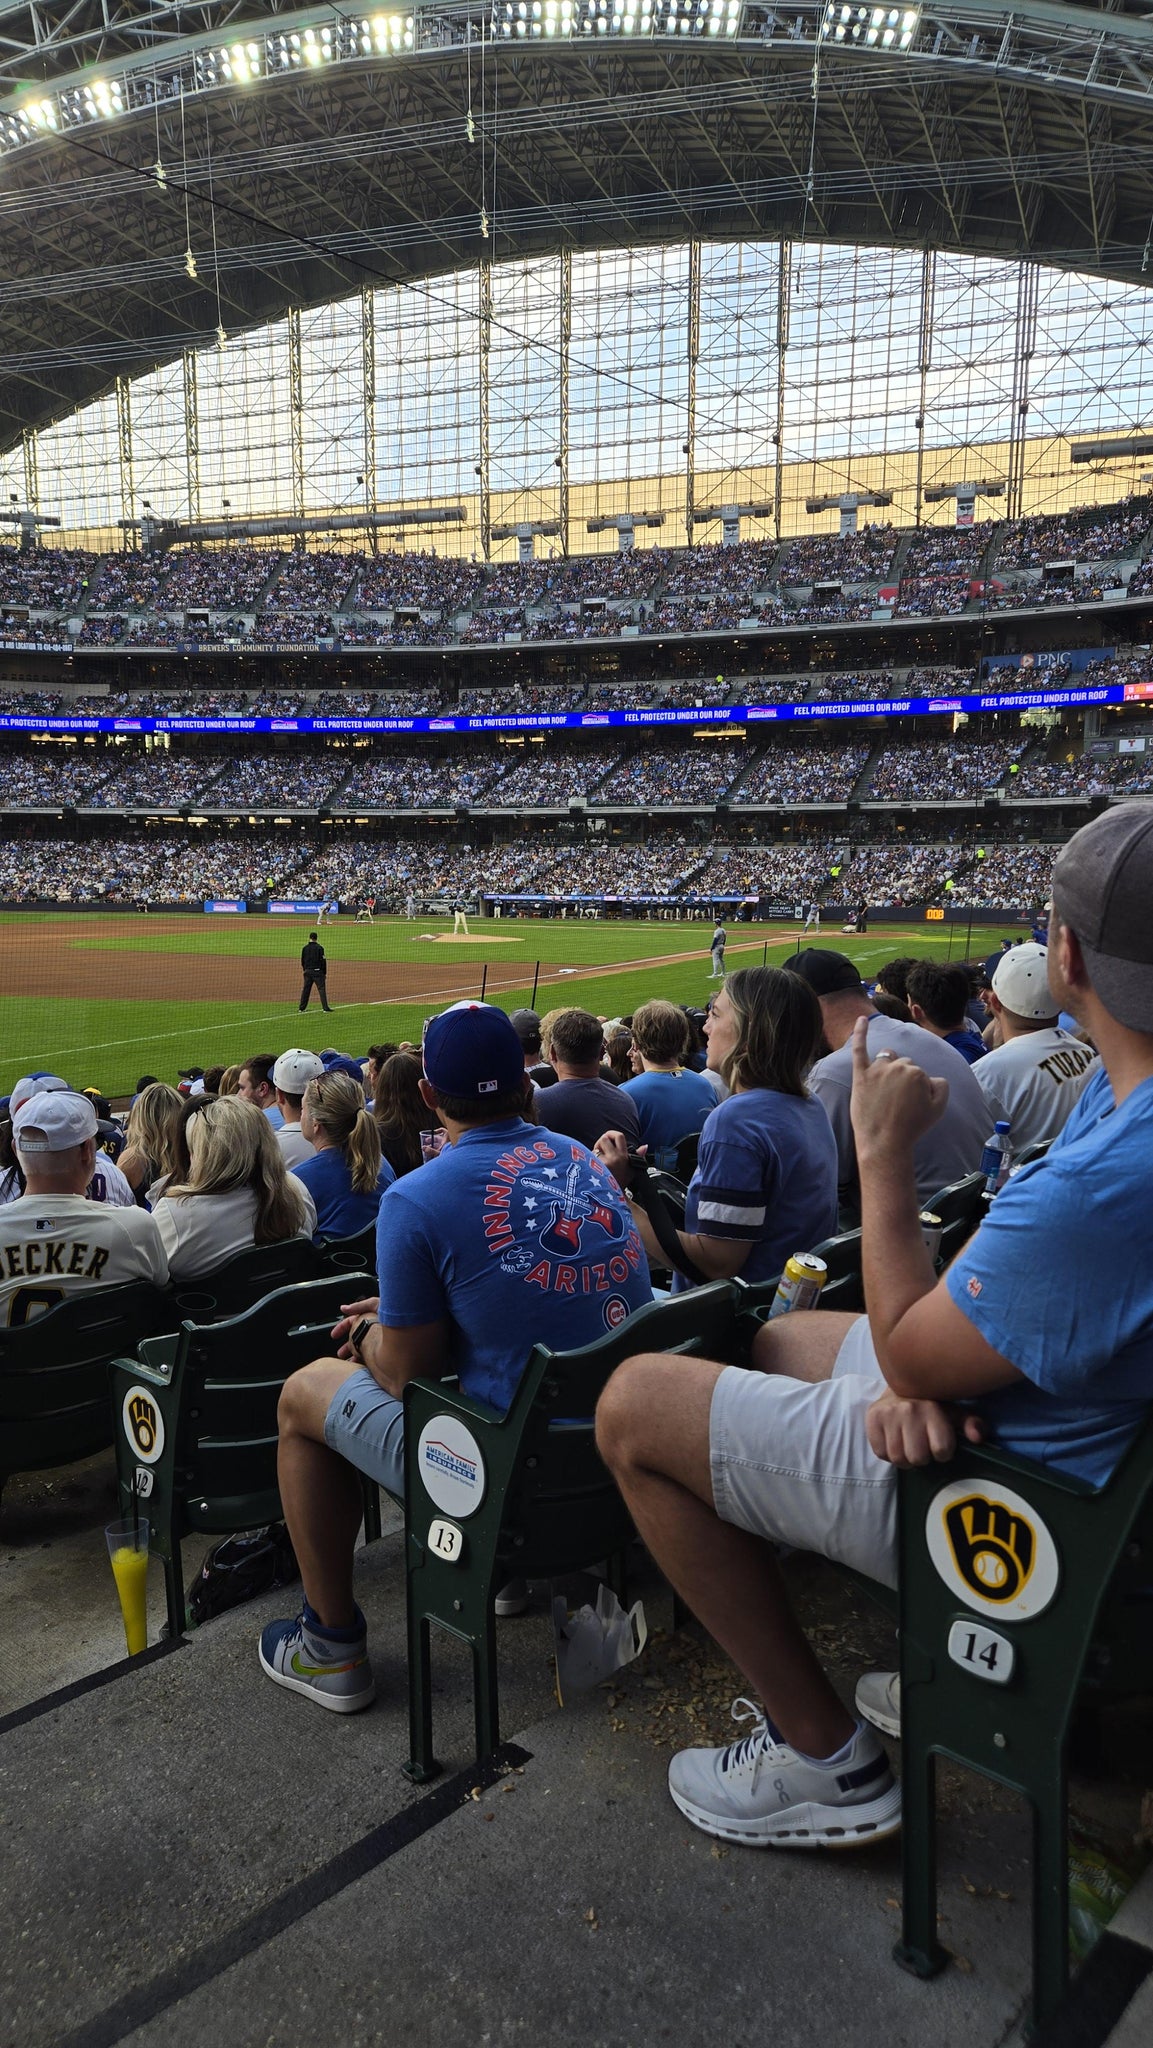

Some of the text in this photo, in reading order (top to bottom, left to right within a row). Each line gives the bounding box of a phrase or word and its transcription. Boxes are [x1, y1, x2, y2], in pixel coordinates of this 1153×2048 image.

[15, 642, 36, 650] LOCATION
[198, 644, 320, 652] BREWERS COMMUNITY FOUNDATION
[1037, 652, 1071, 666] PNC
[980, 690, 1108, 707] FEEL PROTECTED UNDER OUR ROOF
[624, 709, 731, 722] FEEL PROTECTED UNDER OUR ROOF
[794, 702, 911, 715] FEEL PROTECTED UNDER OUR ROOF
[10, 718, 47, 728] PROTECTED
[48, 719, 69, 728] UNDER
[70, 720, 83, 728] OUR
[83, 720, 99, 728] ROOF
[156, 720, 256, 729] FEEL PROTECTED UNDER OUR ROOF
[313, 720, 414, 729] FEEL PROTECTED UNDER OUR ROOF
[469, 716, 567, 727] FEEL PROTECTED UNDER OUR ROOF
[483, 1141, 557, 1253] INNINGS
[0, 1241, 110, 1280] ECKER
[523, 1229, 642, 1293] ARIZONA
[426, 1445, 477, 1474] AMERICAN FAMILY
[428, 1453, 473, 1480] INSURANCE
[136, 1473, 149, 1493] 12
[434, 1527, 455, 1554] 13
[961, 1632, 999, 1671] 14
